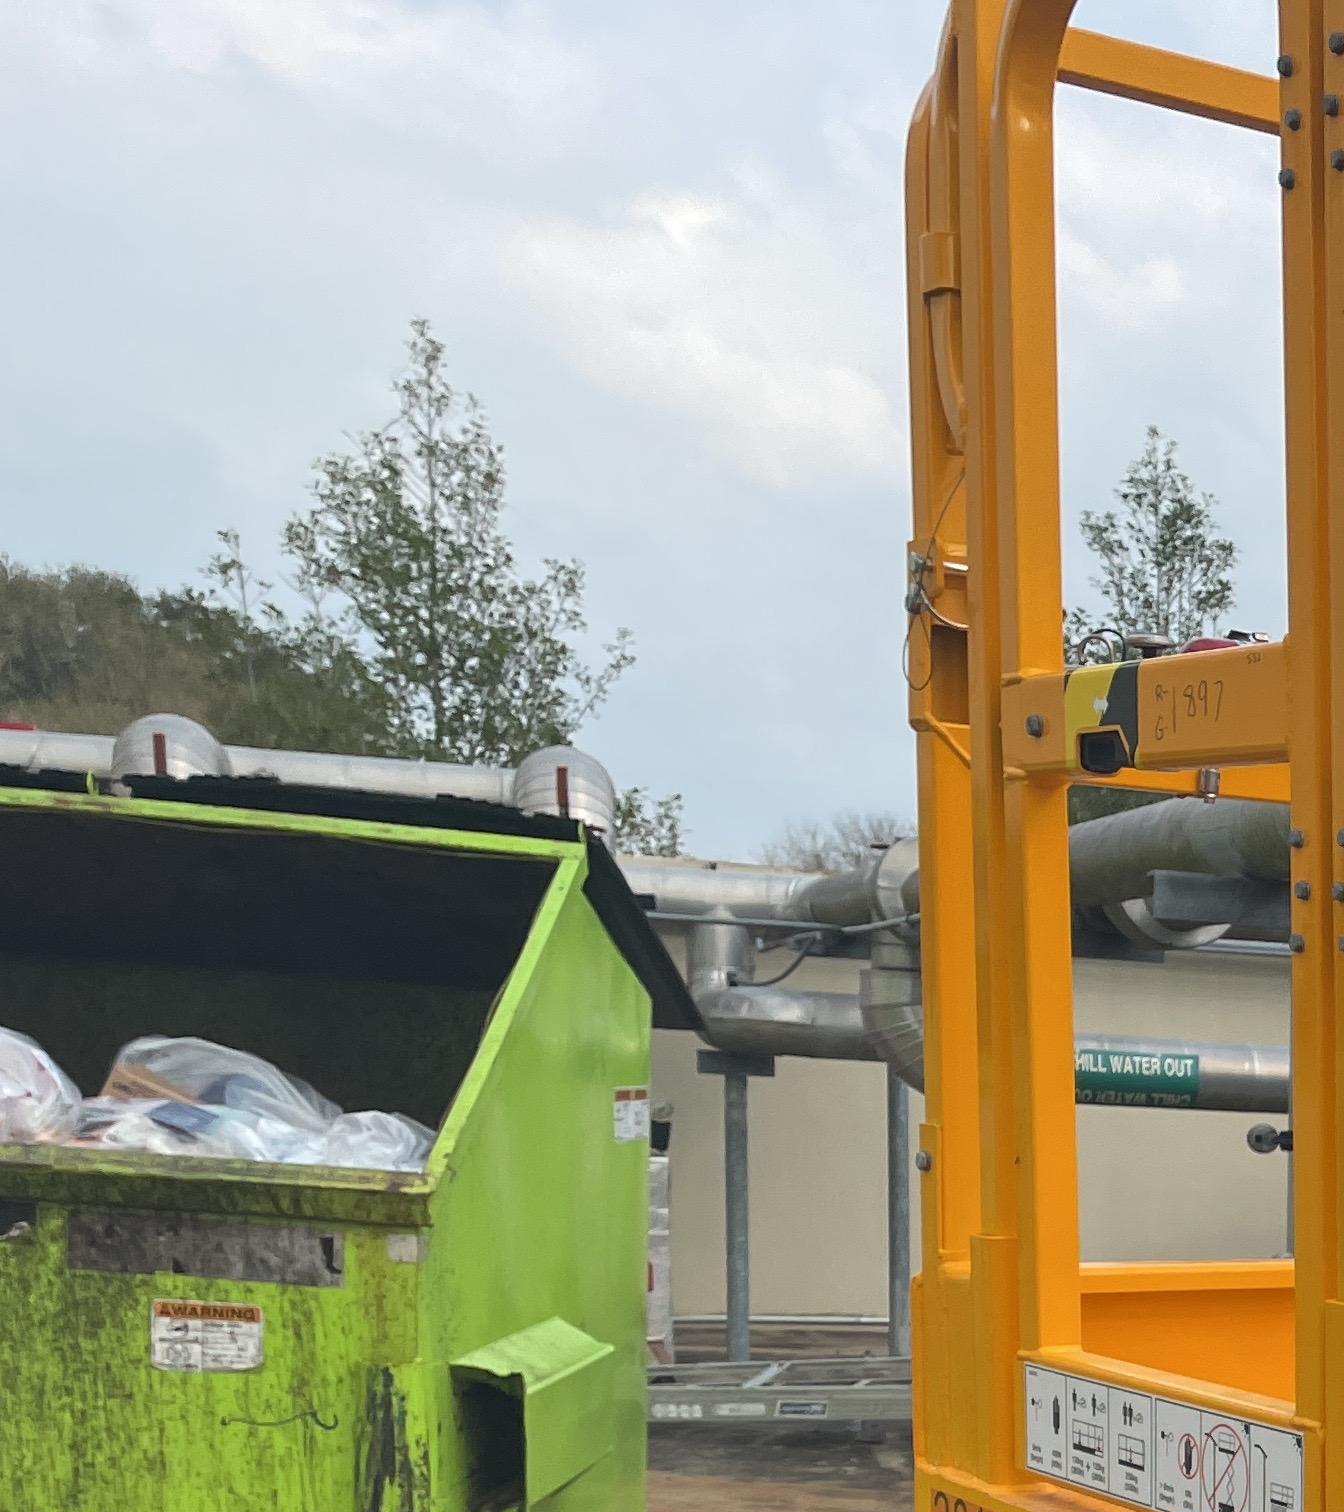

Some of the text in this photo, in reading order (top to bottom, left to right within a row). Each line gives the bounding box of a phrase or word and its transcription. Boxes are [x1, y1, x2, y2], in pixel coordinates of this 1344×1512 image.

[1075, 1053, 1194, 1078] HILL WATER OUT
[171, 1304, 256, 1321] WARNING
